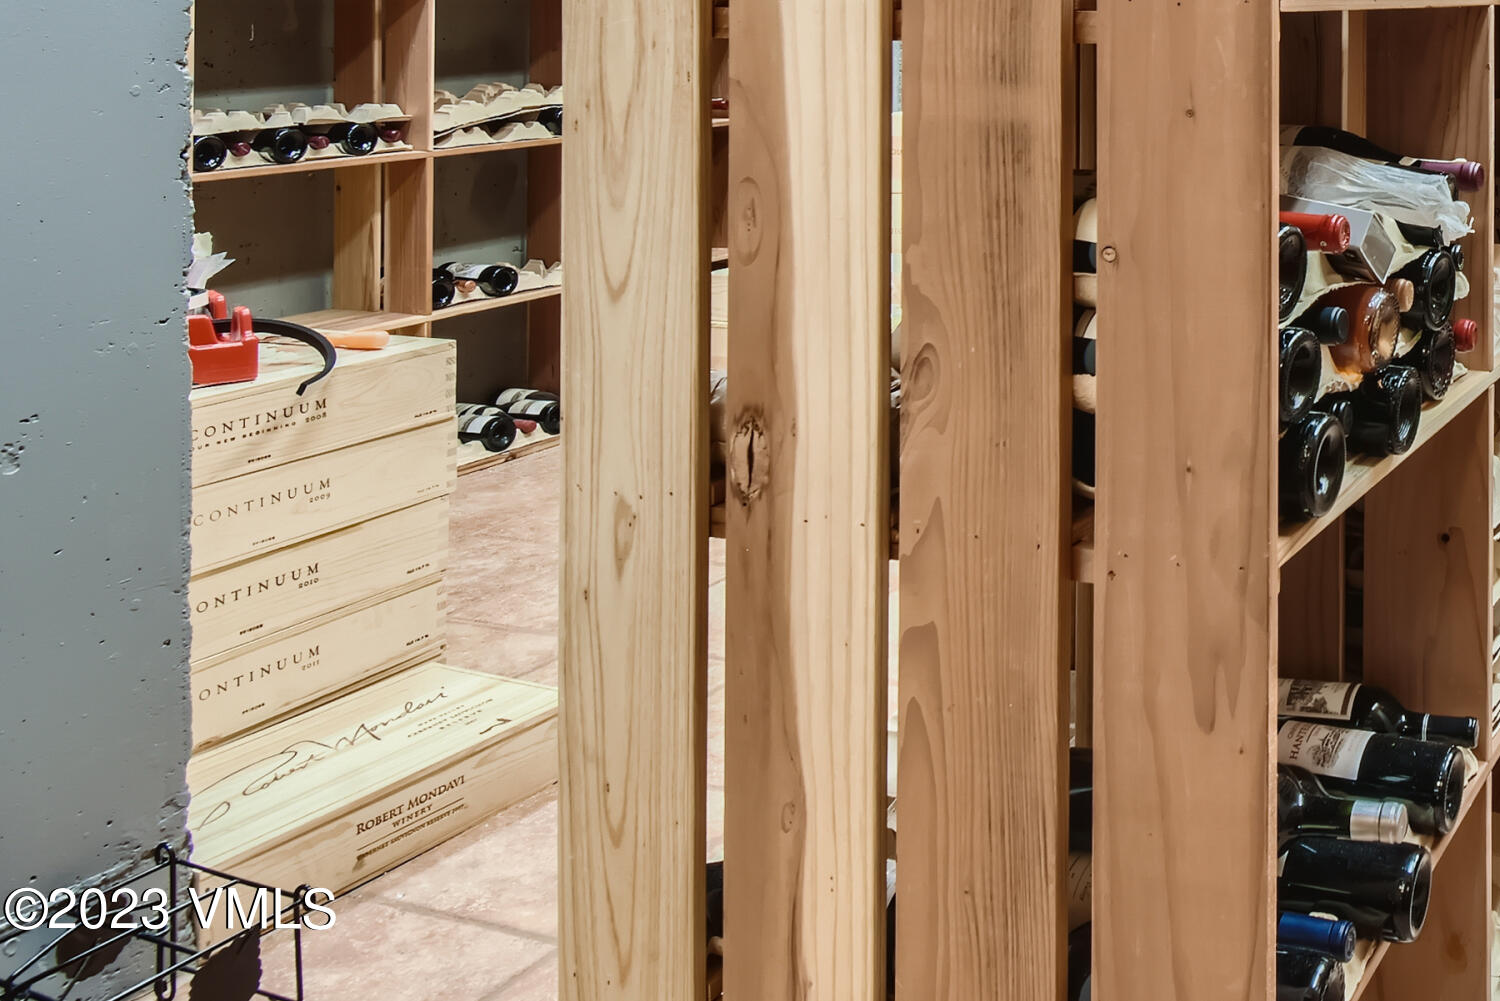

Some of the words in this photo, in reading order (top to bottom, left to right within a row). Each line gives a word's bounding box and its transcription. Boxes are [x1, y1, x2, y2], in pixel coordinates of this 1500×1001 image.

[191, 398, 327, 442] CONTINUUM
[193, 477, 331, 527] CONTINUUM
[196, 562, 319, 613] ONTINUUM
[198, 645, 320, 701] ONTINUUM
[356, 803, 404, 835] ROBERT
[407, 774, 465, 811] MONDAVI
[392, 803, 433, 828] WINERY
